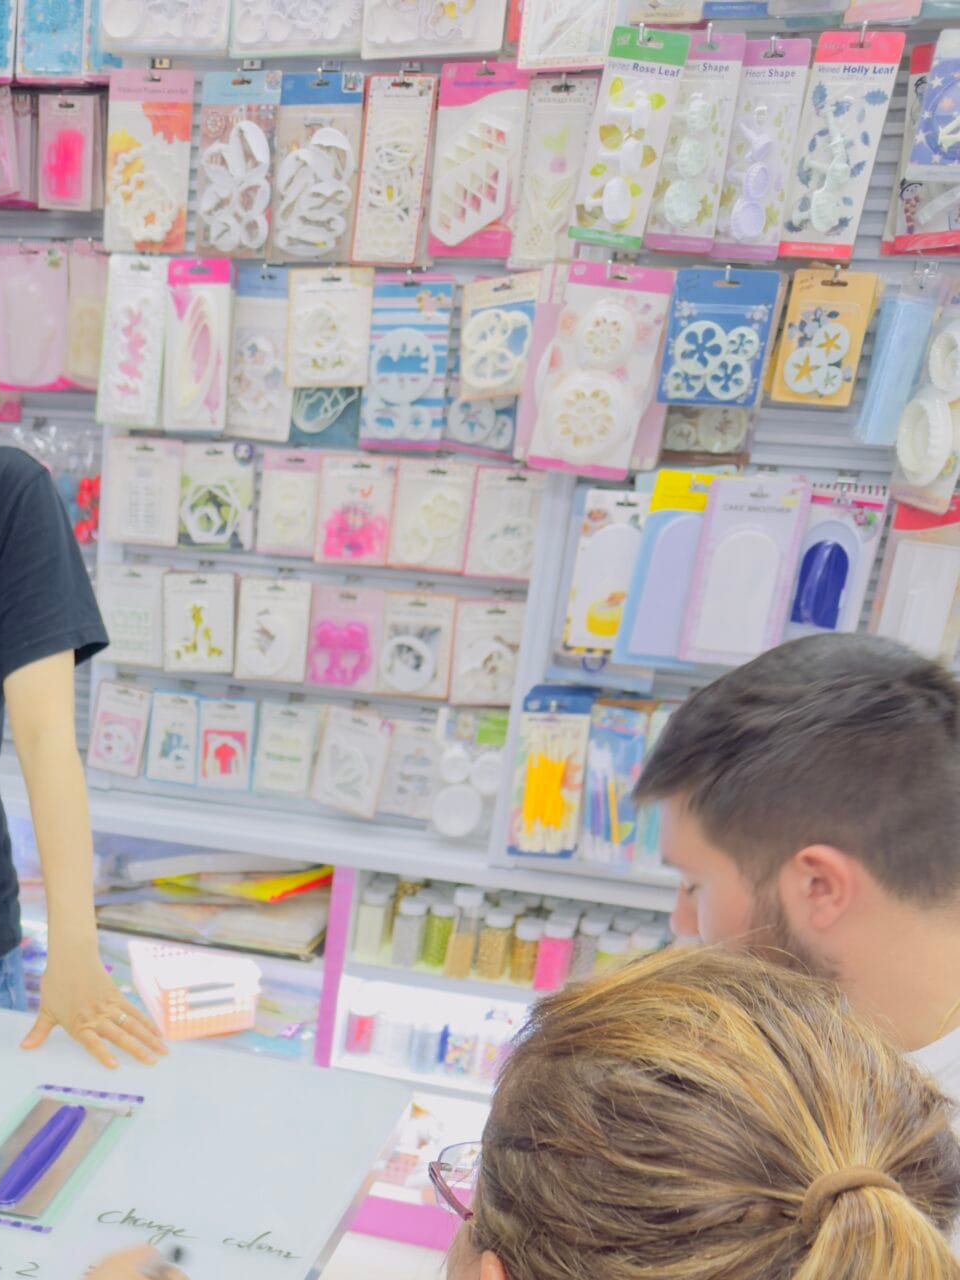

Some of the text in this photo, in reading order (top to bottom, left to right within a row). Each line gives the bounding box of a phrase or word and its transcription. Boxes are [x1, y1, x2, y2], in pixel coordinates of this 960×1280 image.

[632, 62, 656, 74] Rose
[658, 66, 681, 78] Leaf
[702, 62, 730, 75] Shape
[842, 65, 869, 76] Holly
[872, 65, 894, 75] Leaf
[767, 69, 797, 81] Shape
